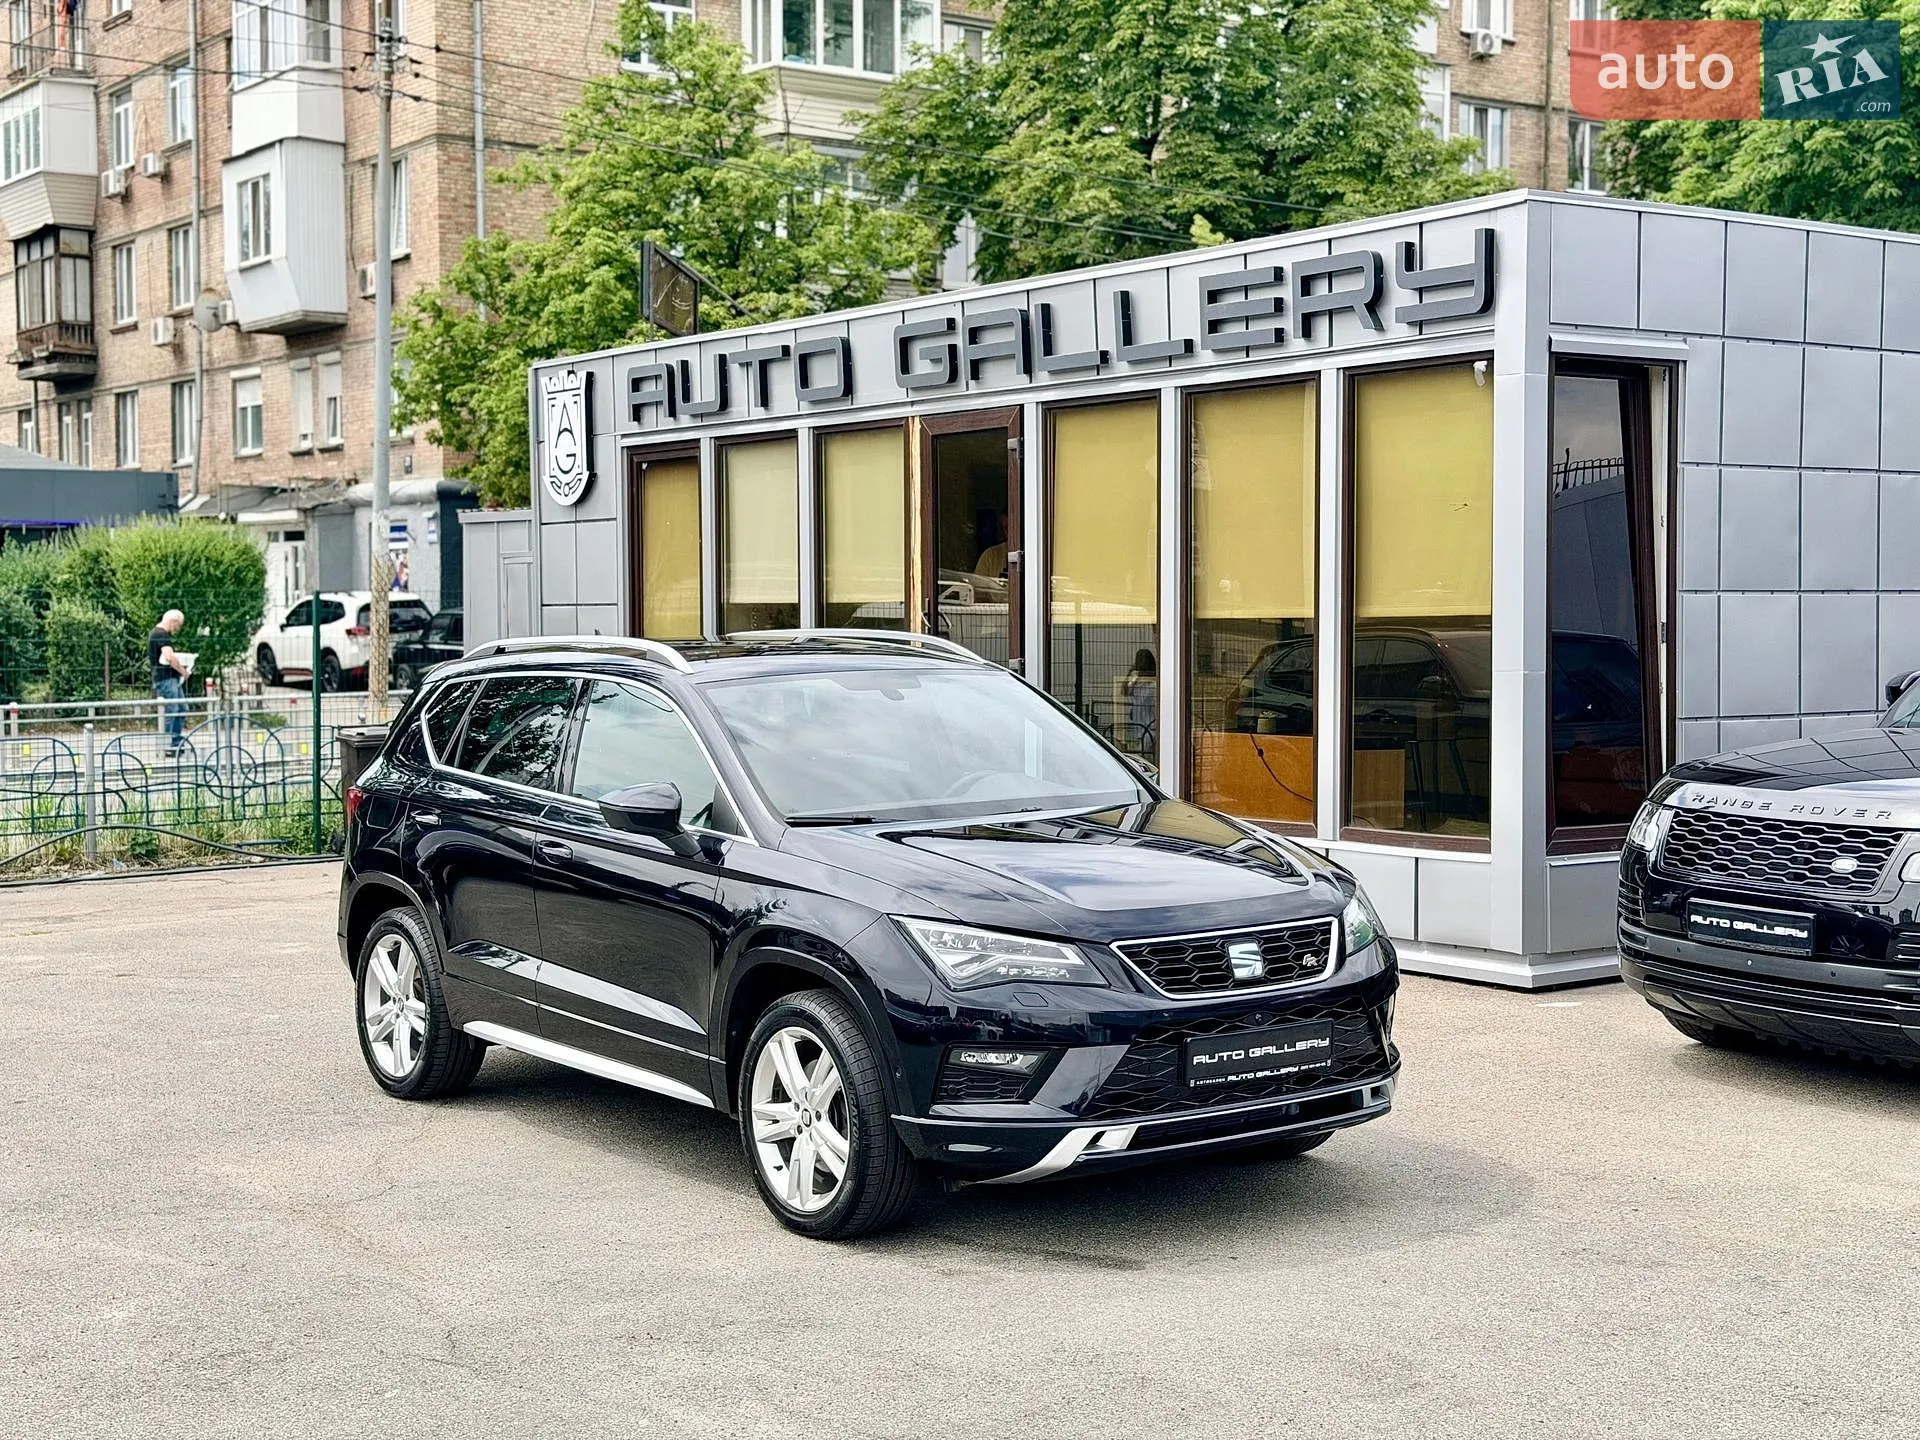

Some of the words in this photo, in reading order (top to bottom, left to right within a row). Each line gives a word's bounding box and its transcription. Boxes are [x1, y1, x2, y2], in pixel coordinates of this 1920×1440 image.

[627, 336, 850, 423] AUTO
[894, 228, 1495, 389] GALLERY
[1691, 792, 1773, 811] RANGE
[1789, 804, 1893, 820] ROVER
[1690, 914, 1731, 928] AUTO
[1732, 920, 1808, 938] GALLERY
[1193, 1050, 1245, 1065] AUTO
[1248, 1037, 1330, 1057] GALLERY
[1227, 1072, 1255, 1081] AUTO
[1255, 1065, 1299, 1078] GALLERY
